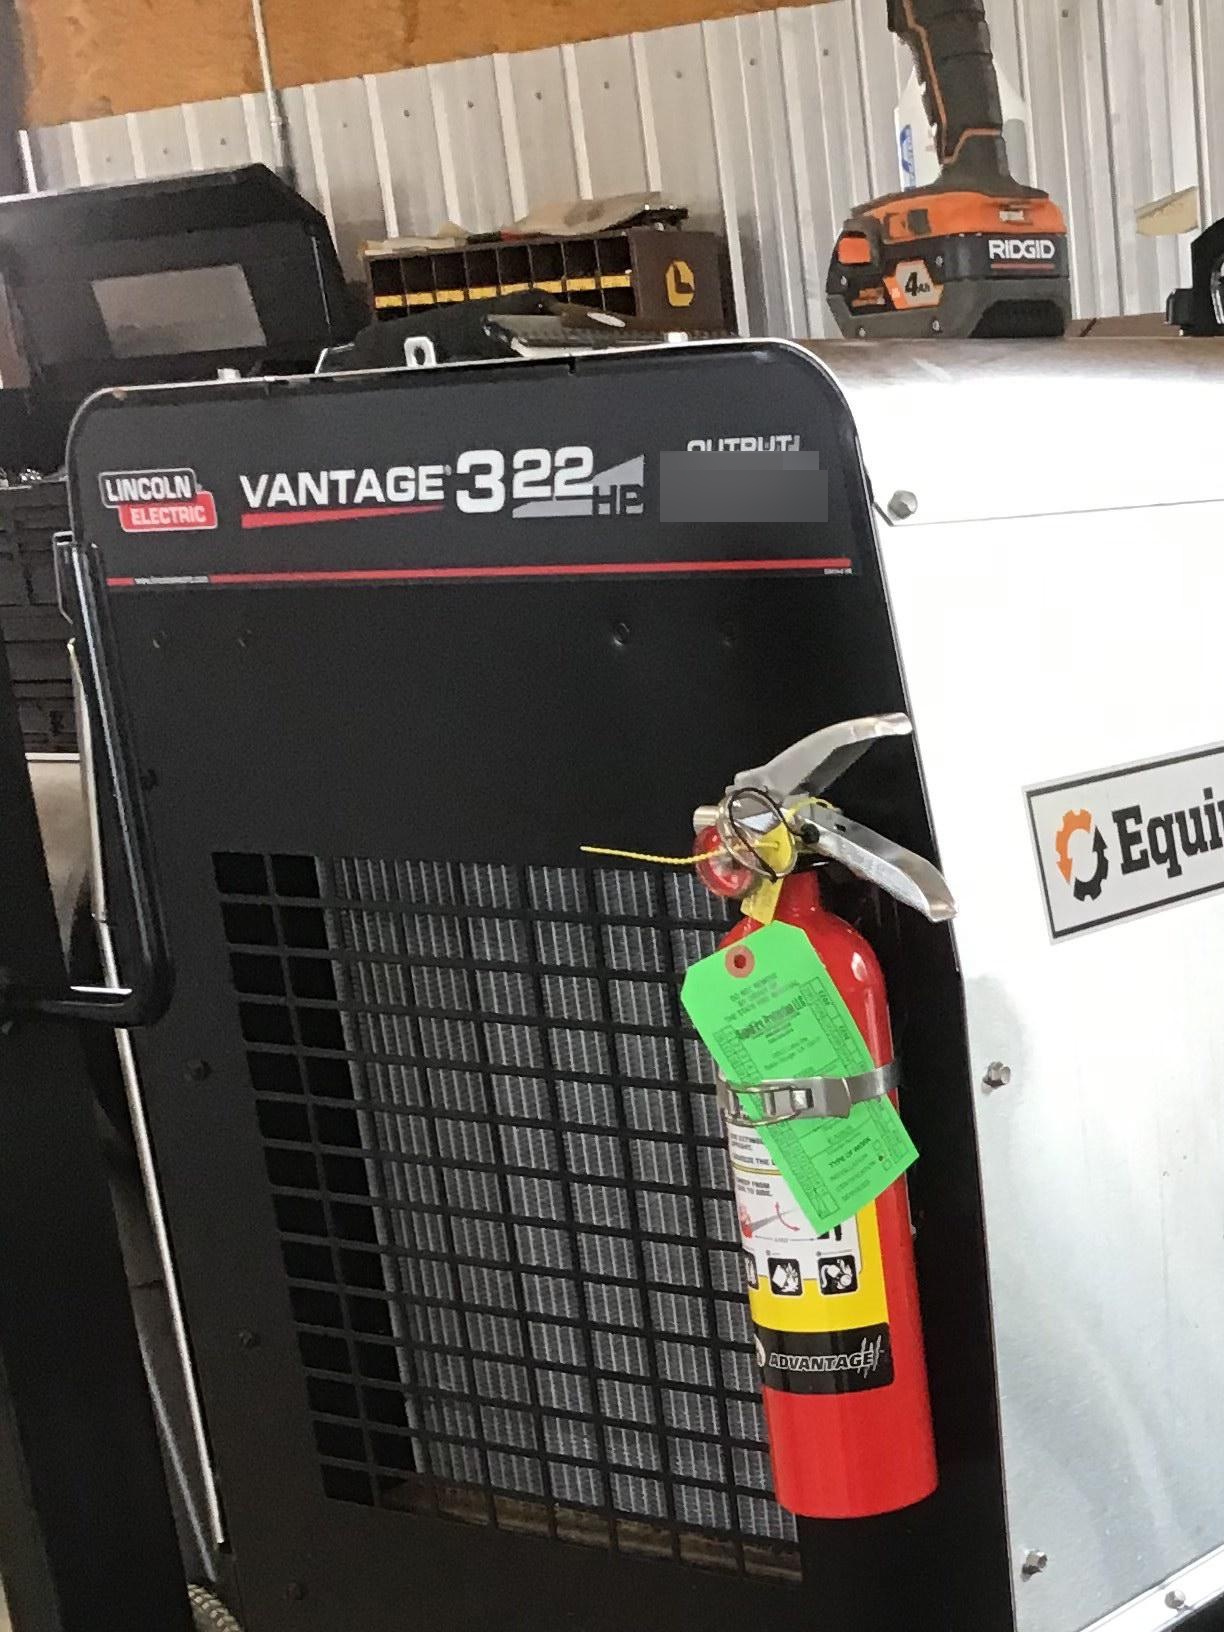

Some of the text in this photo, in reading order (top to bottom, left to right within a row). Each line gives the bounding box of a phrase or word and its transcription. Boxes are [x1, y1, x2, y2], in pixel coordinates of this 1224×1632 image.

[988, 240, 1055, 259] RIDGID
[105, 475, 192, 502] LINCOLN
[240, 465, 446, 508] VANTAGE
[456, 446, 594, 514] 322
[130, 505, 206, 525] ELECTRIC
[769, 1351, 873, 1373] ADVANTAGE
